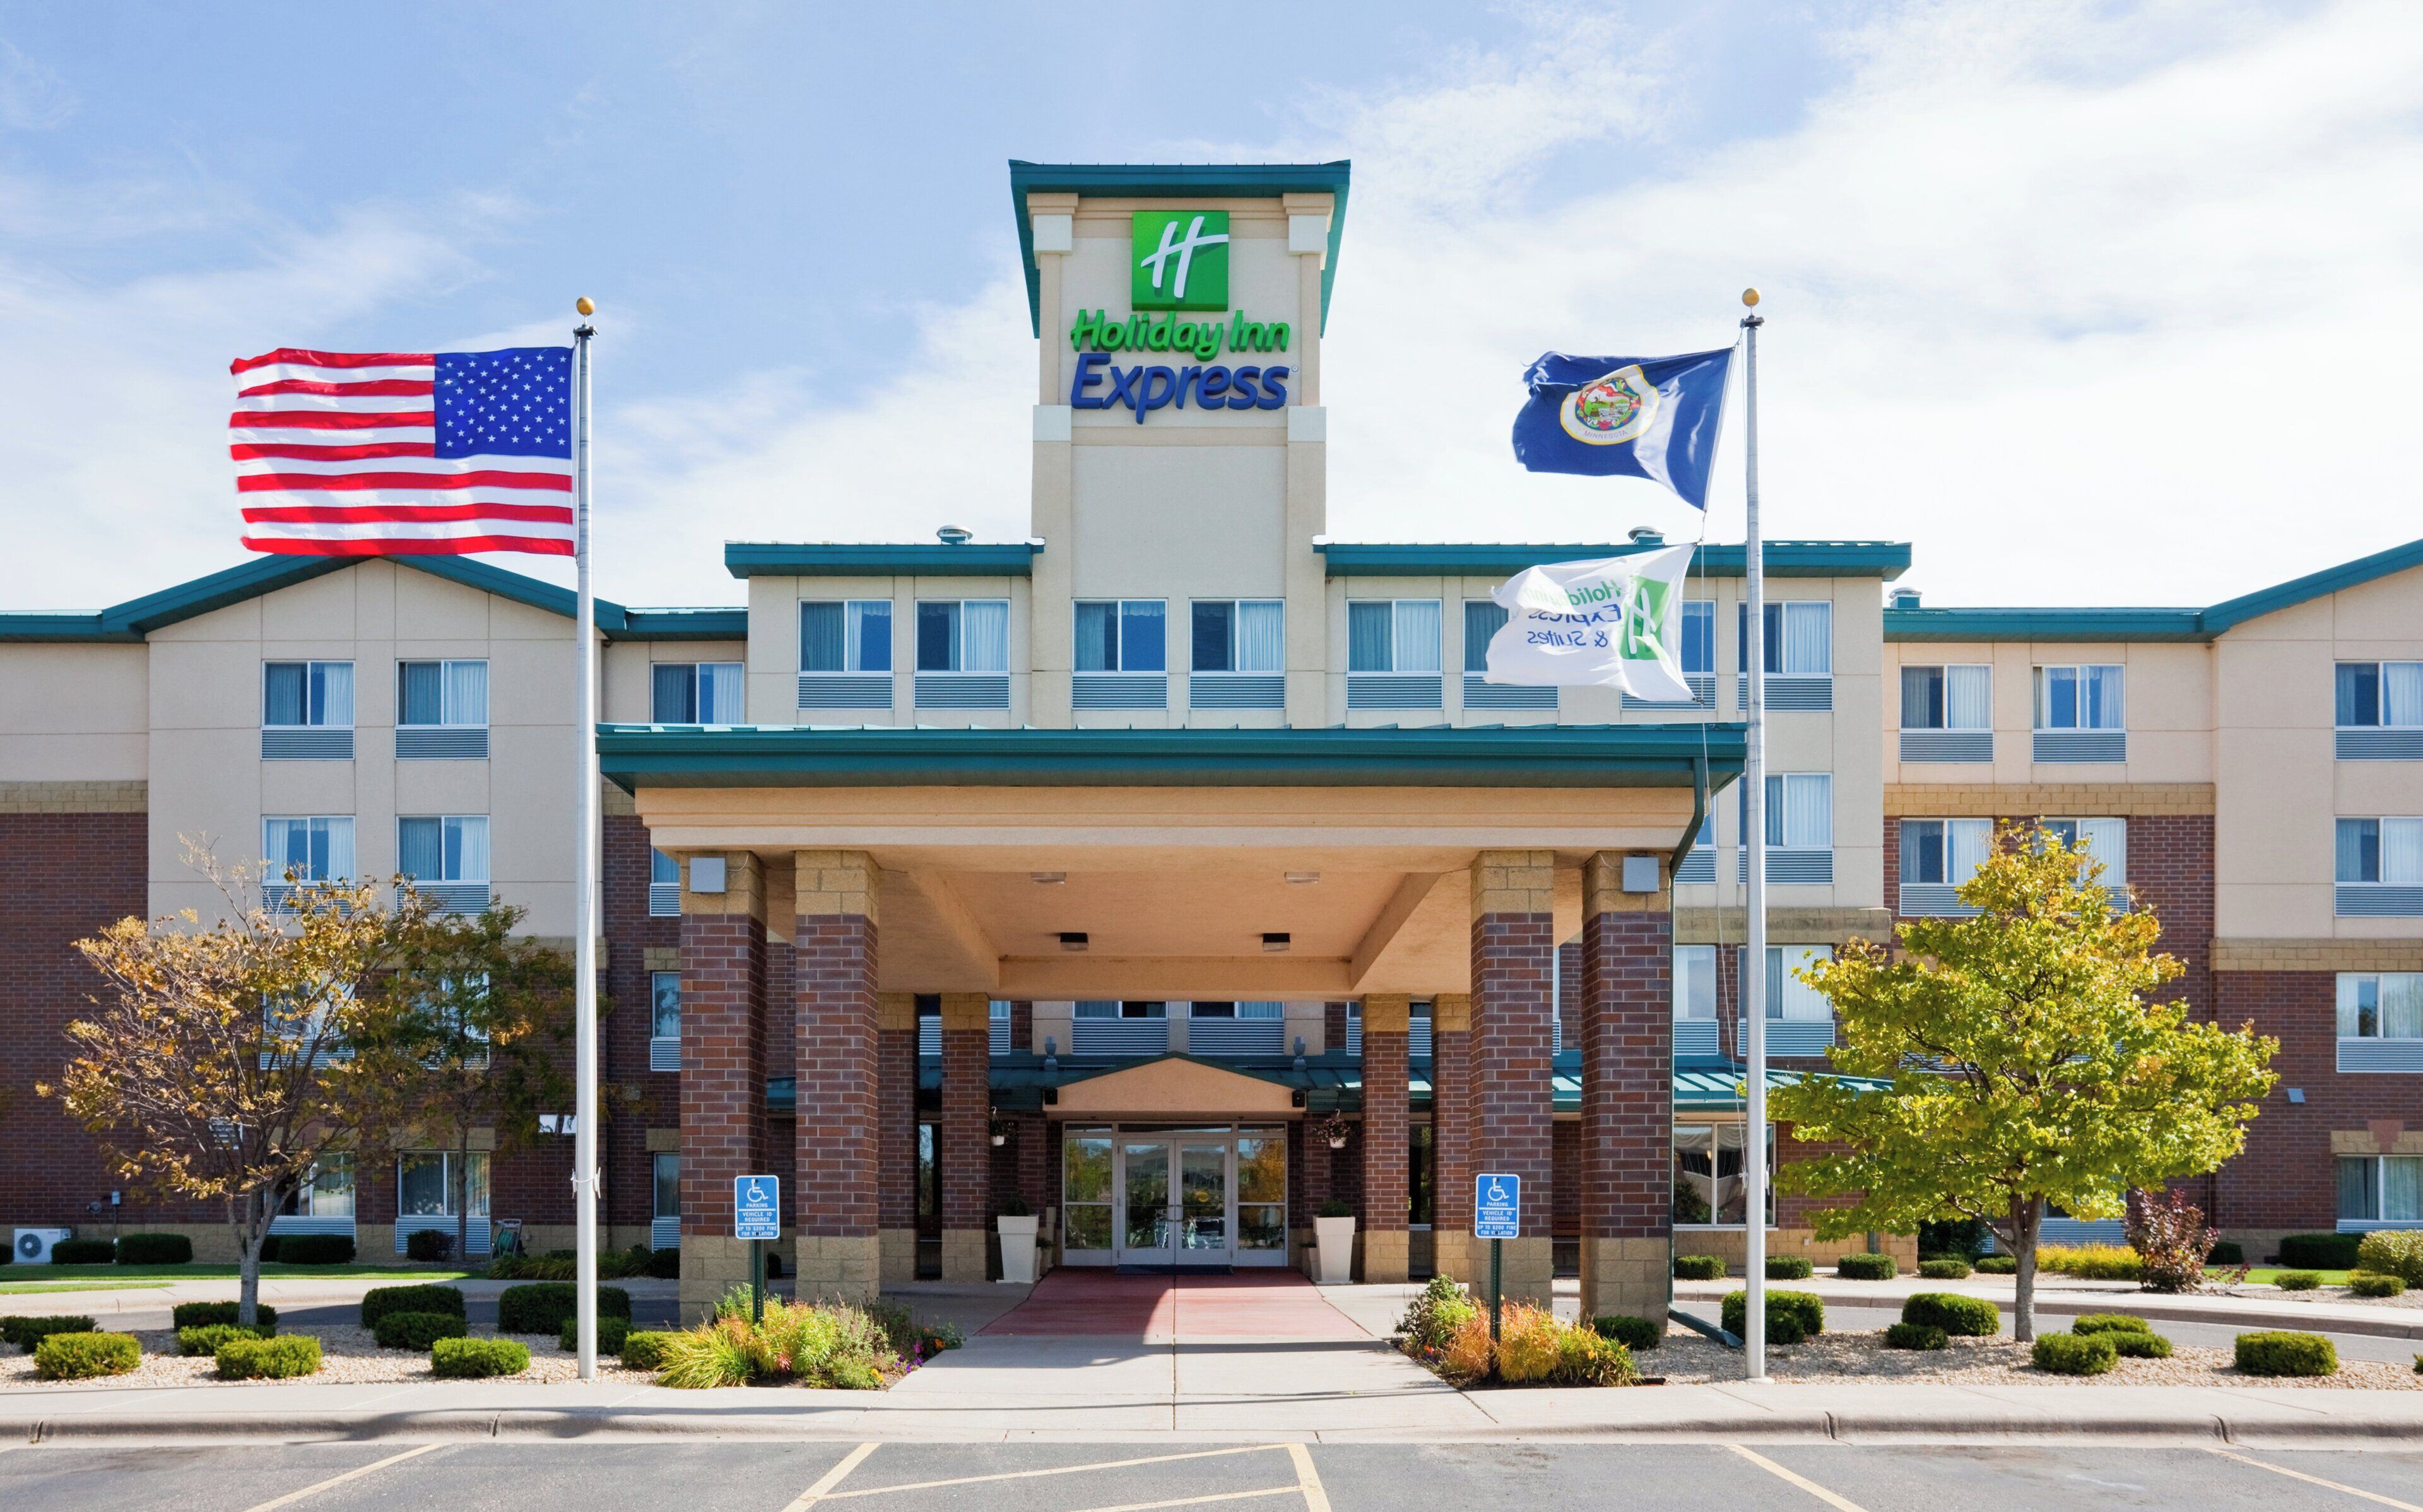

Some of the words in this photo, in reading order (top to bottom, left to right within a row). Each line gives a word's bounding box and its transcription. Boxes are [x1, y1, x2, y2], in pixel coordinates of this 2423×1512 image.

[1141, 216, 1229, 298] H
[1071, 309, 1223, 361] Holiday
[1229, 310, 1290, 352] Inn
[1071, 353, 1290, 425] Express
[1584, 430, 1628, 439] MINNESOTA
